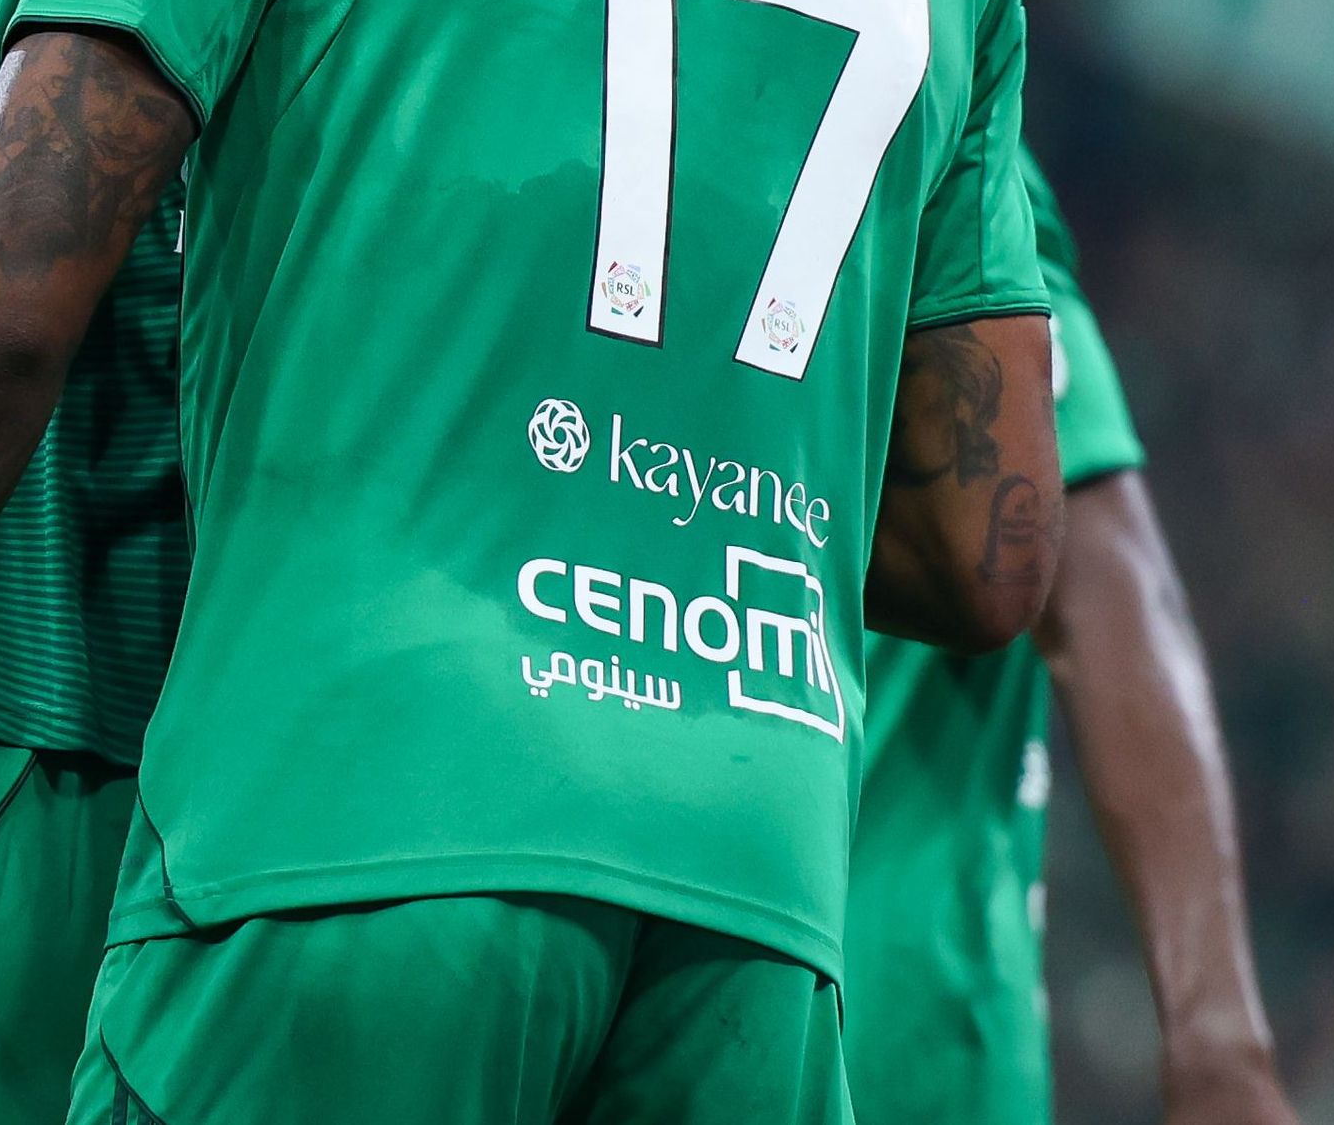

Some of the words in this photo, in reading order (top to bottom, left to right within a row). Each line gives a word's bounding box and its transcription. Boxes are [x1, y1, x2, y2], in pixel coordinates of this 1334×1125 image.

[616, 281, 636, 297] RSL
[610, 413, 830, 549] kayanee
[521, 651, 682, 711] سينومي
